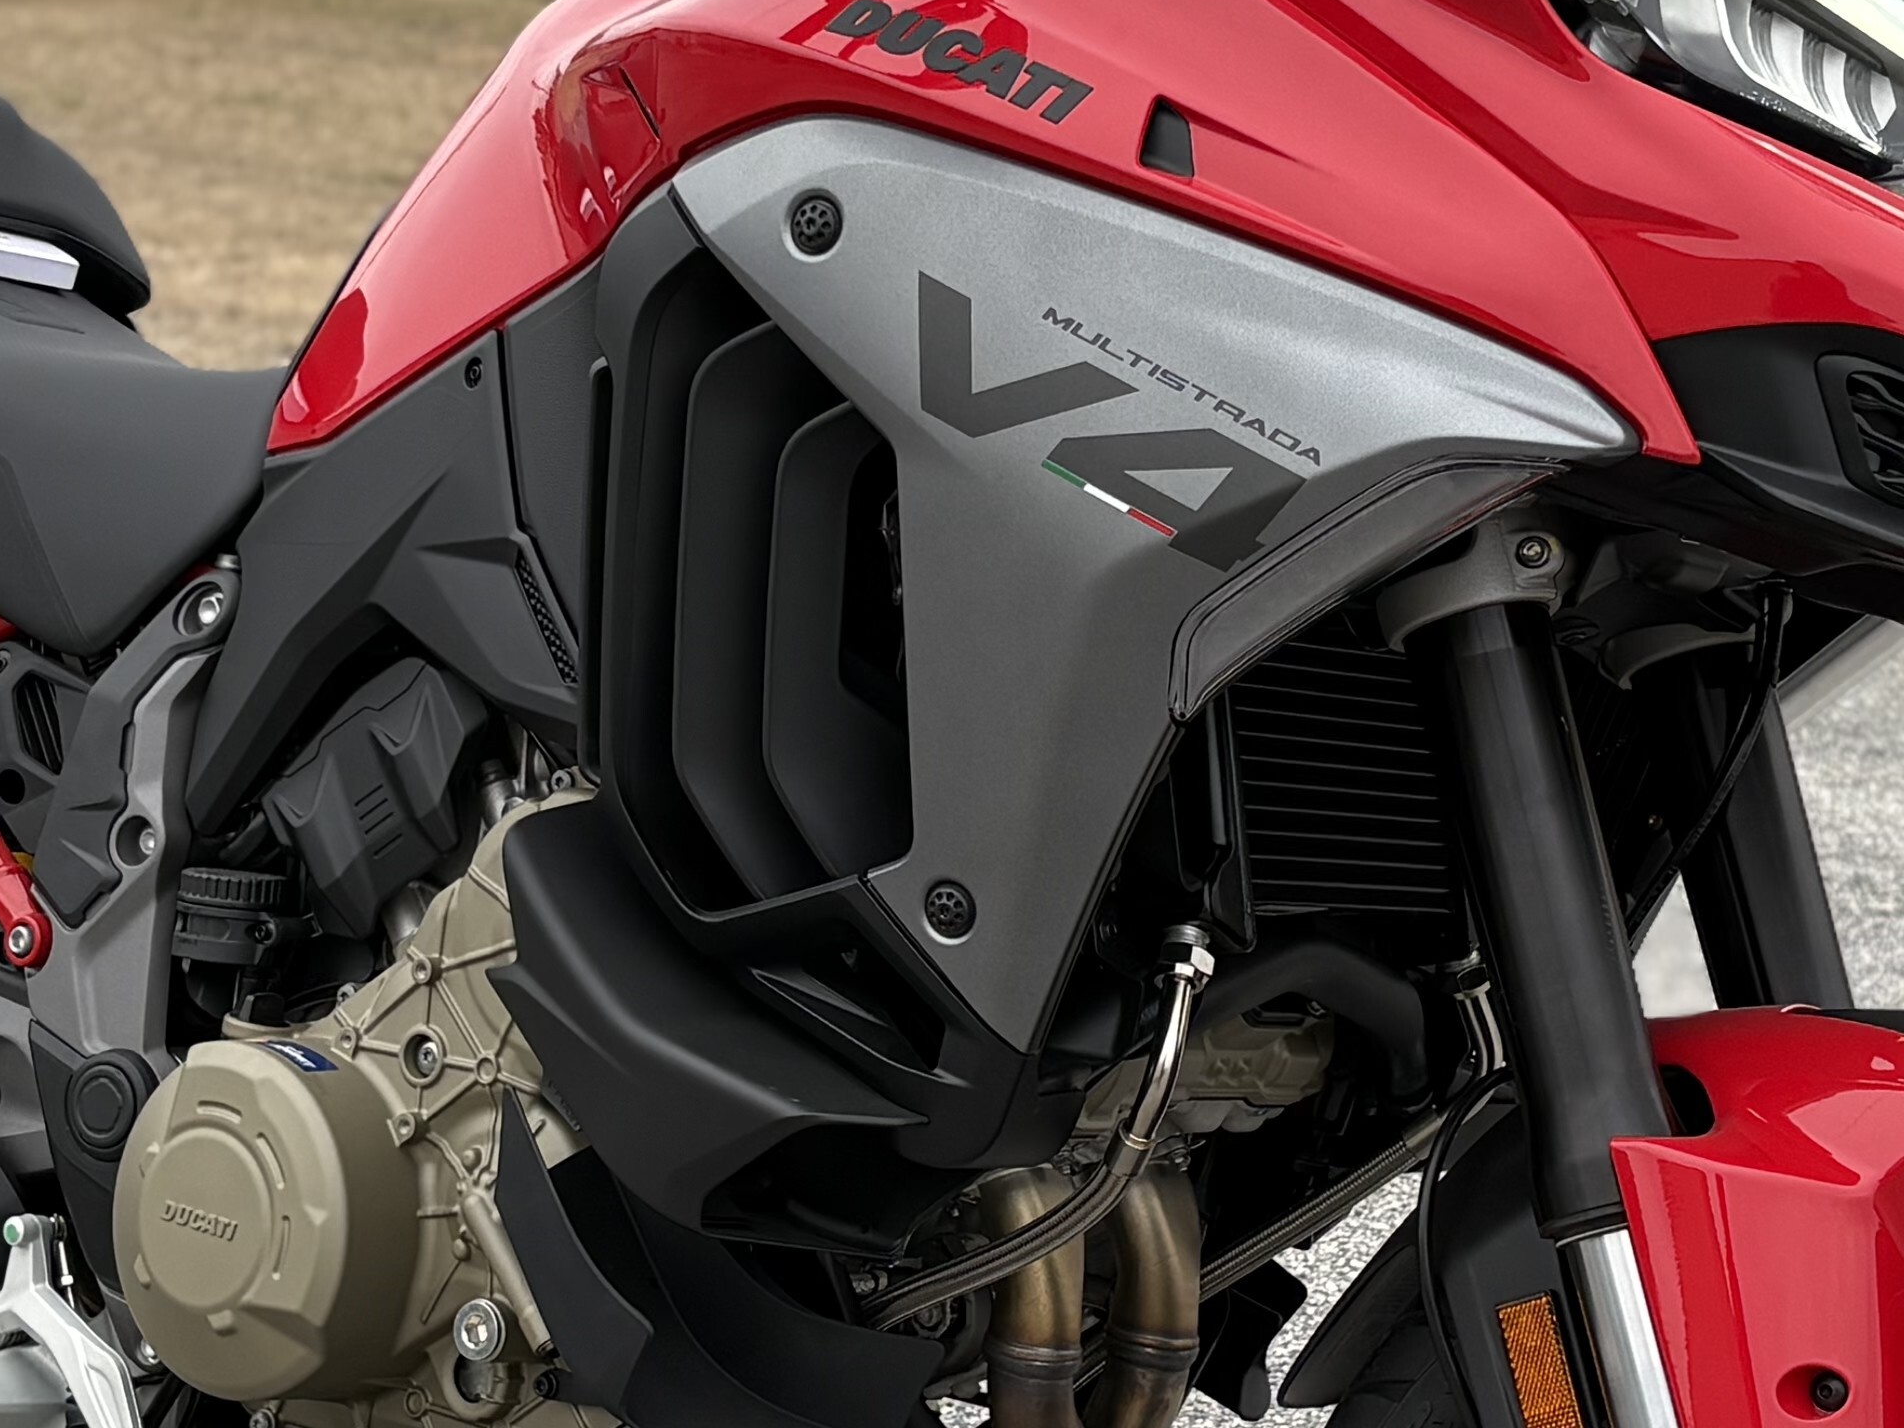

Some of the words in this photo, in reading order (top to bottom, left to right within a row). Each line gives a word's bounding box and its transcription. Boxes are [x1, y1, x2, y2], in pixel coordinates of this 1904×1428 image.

[918, 269, 1309, 572] V4
[1040, 305, 1324, 467] MULTISTRADA
[159, 1199, 239, 1243] DUCATI
